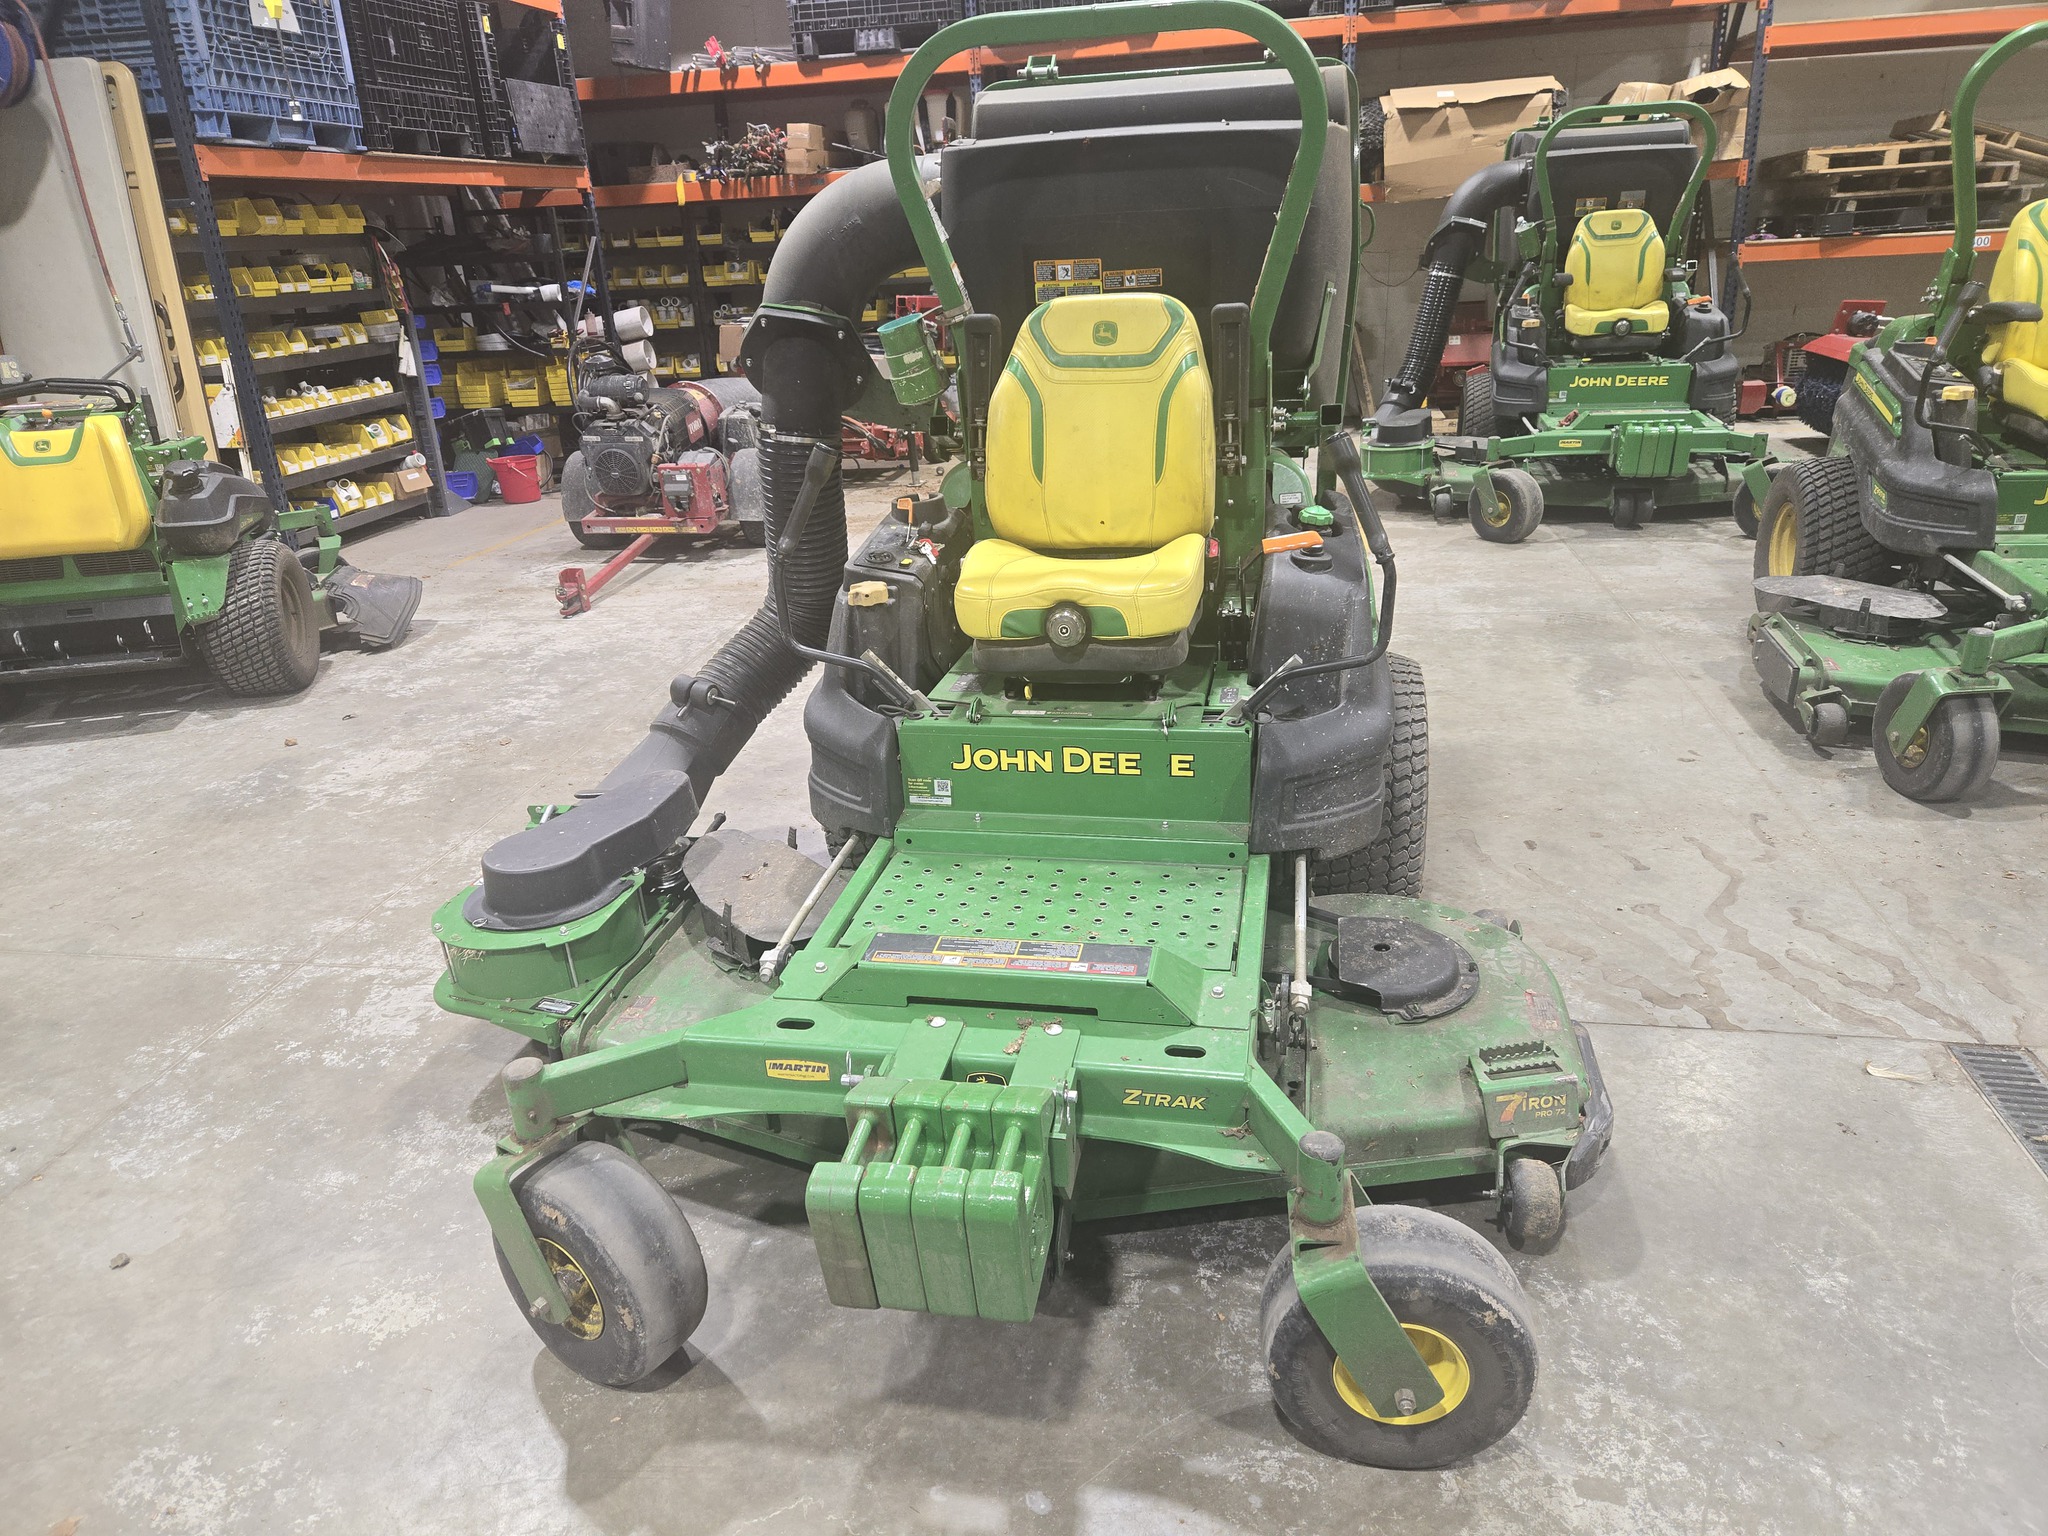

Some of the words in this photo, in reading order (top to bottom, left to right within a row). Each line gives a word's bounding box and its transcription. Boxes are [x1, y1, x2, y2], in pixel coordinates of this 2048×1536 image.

[1569, 376, 1612, 387] JOHN
[1615, 375, 1669, 387] DEERE
[952, 744, 1053, 773] JOHN
[1122, 1088, 1207, 1110] ZTRAK
[1535, 1110, 1552, 1118] PRO
